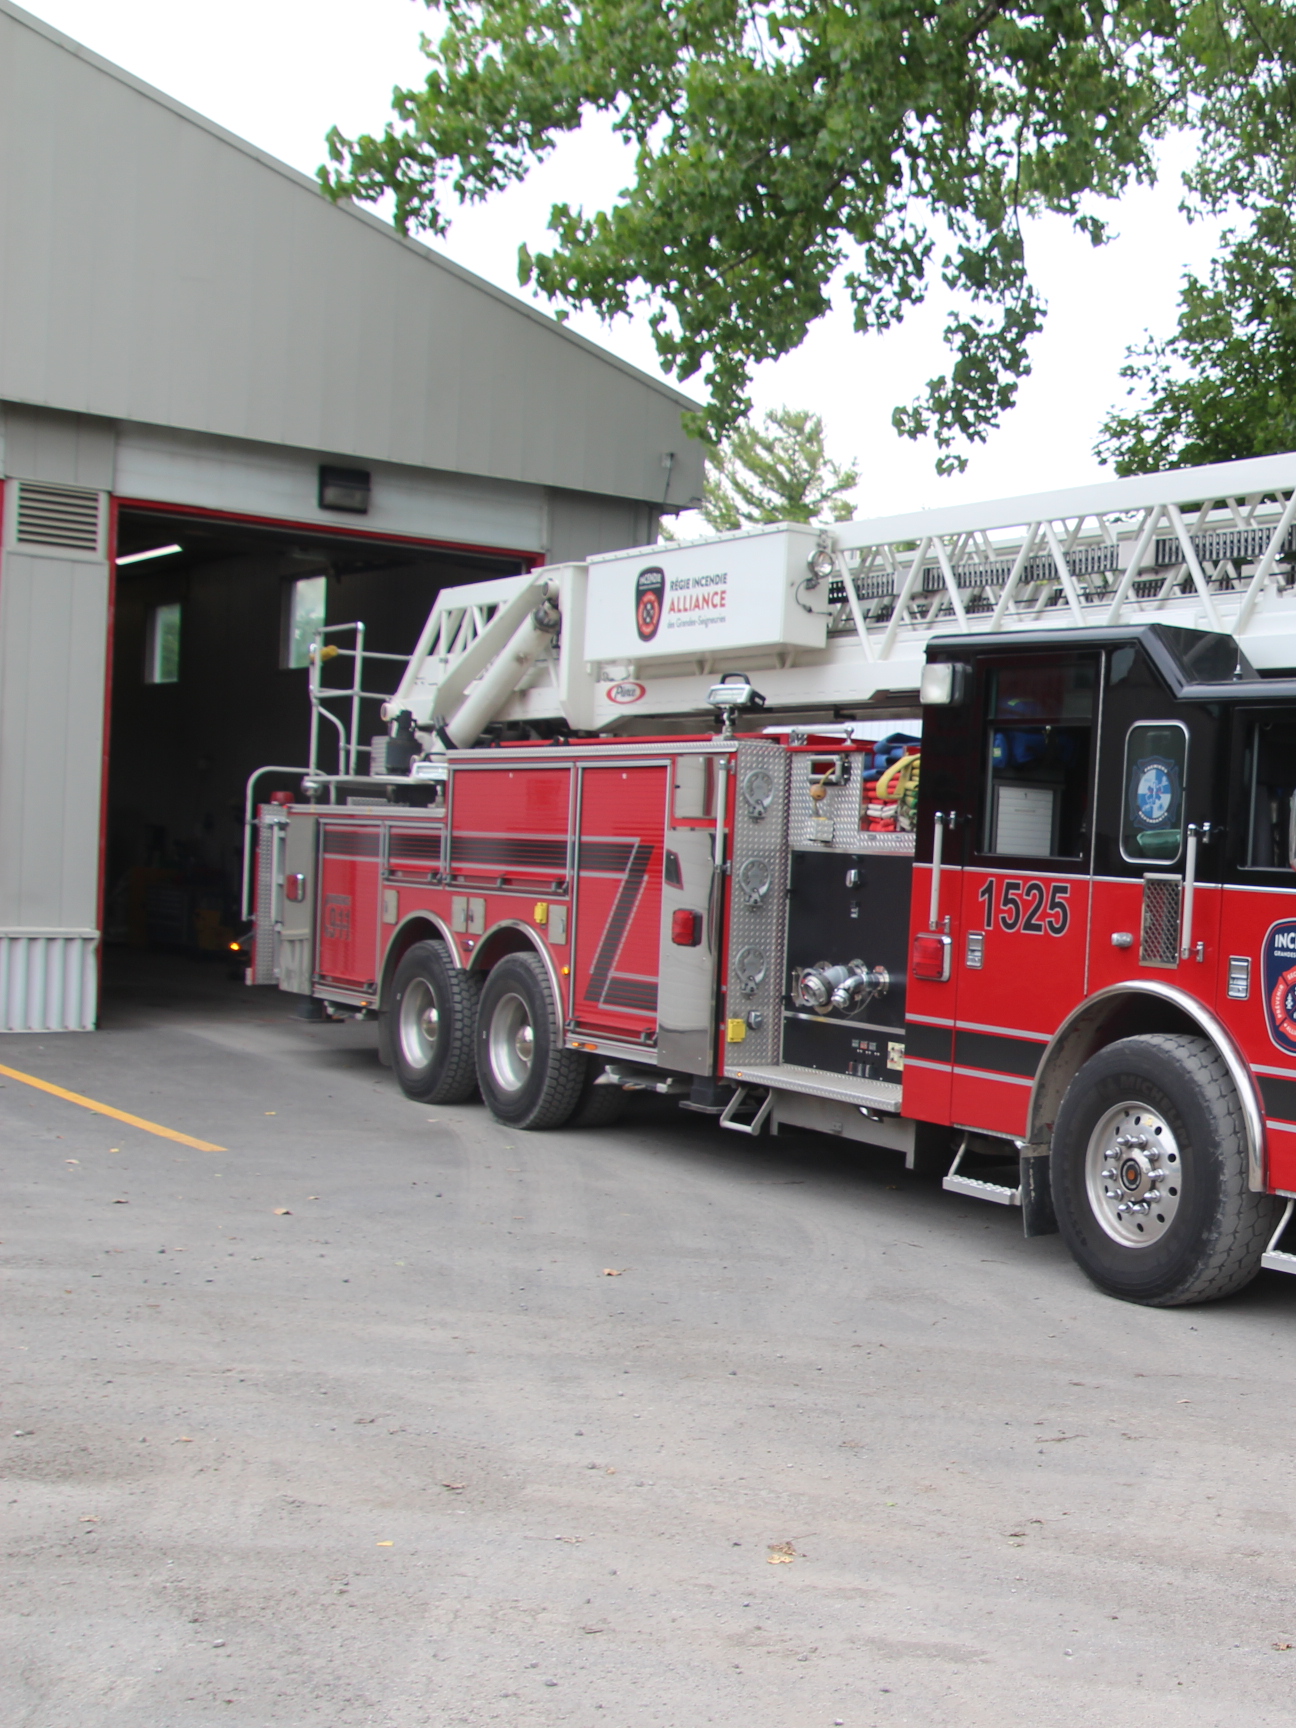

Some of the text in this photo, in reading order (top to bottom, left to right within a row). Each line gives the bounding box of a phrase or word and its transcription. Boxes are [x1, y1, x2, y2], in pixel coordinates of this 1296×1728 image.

[668, 590, 727, 614] ALLIANCE
[670, 577, 691, 591] RÉGIE
[692, 573, 728, 588] INCENDIE
[979, 878, 1070, 937] 1525
[1120, 1074, 1191, 1152] MICHELIN
